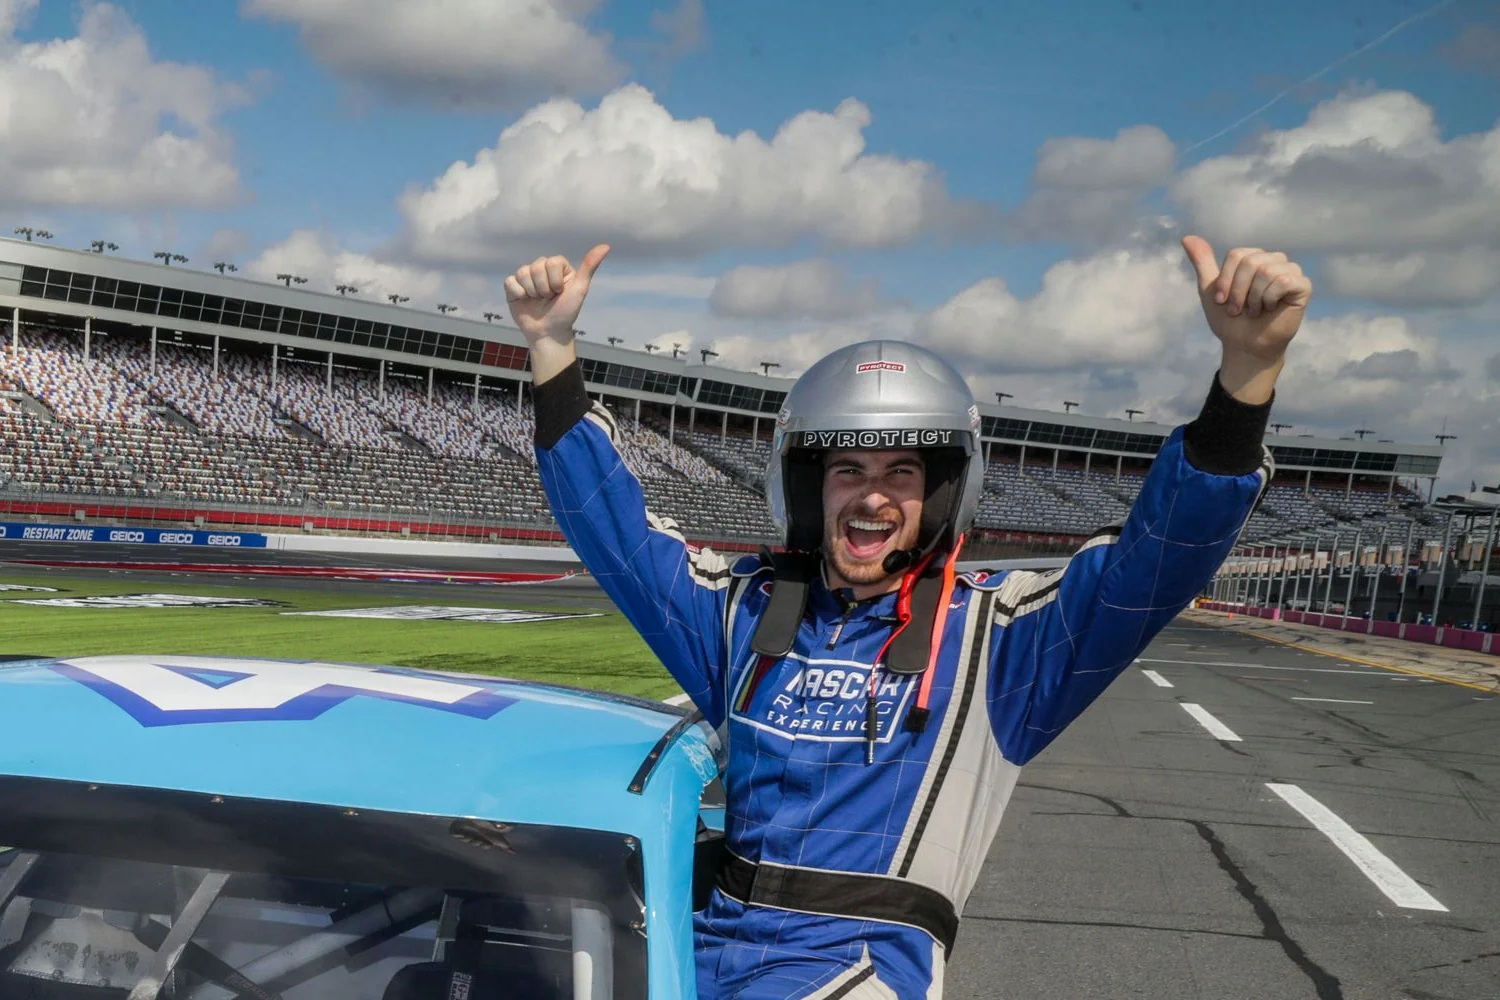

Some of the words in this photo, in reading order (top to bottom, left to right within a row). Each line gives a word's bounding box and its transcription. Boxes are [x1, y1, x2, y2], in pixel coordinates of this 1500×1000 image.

[859, 362, 903, 372] PYROTECT
[803, 429, 952, 447] PYROTECT
[22, 526, 66, 541] RESTART
[67, 529, 94, 542] ZONE
[109, 530, 145, 542] GEICO
[159, 532, 194, 544] GEICO
[207, 534, 241, 546] GEICO
[785, 668, 905, 700] NASCAR
[773, 693, 893, 715] RACING
[767, 710, 884, 732] EXPERIENCE
